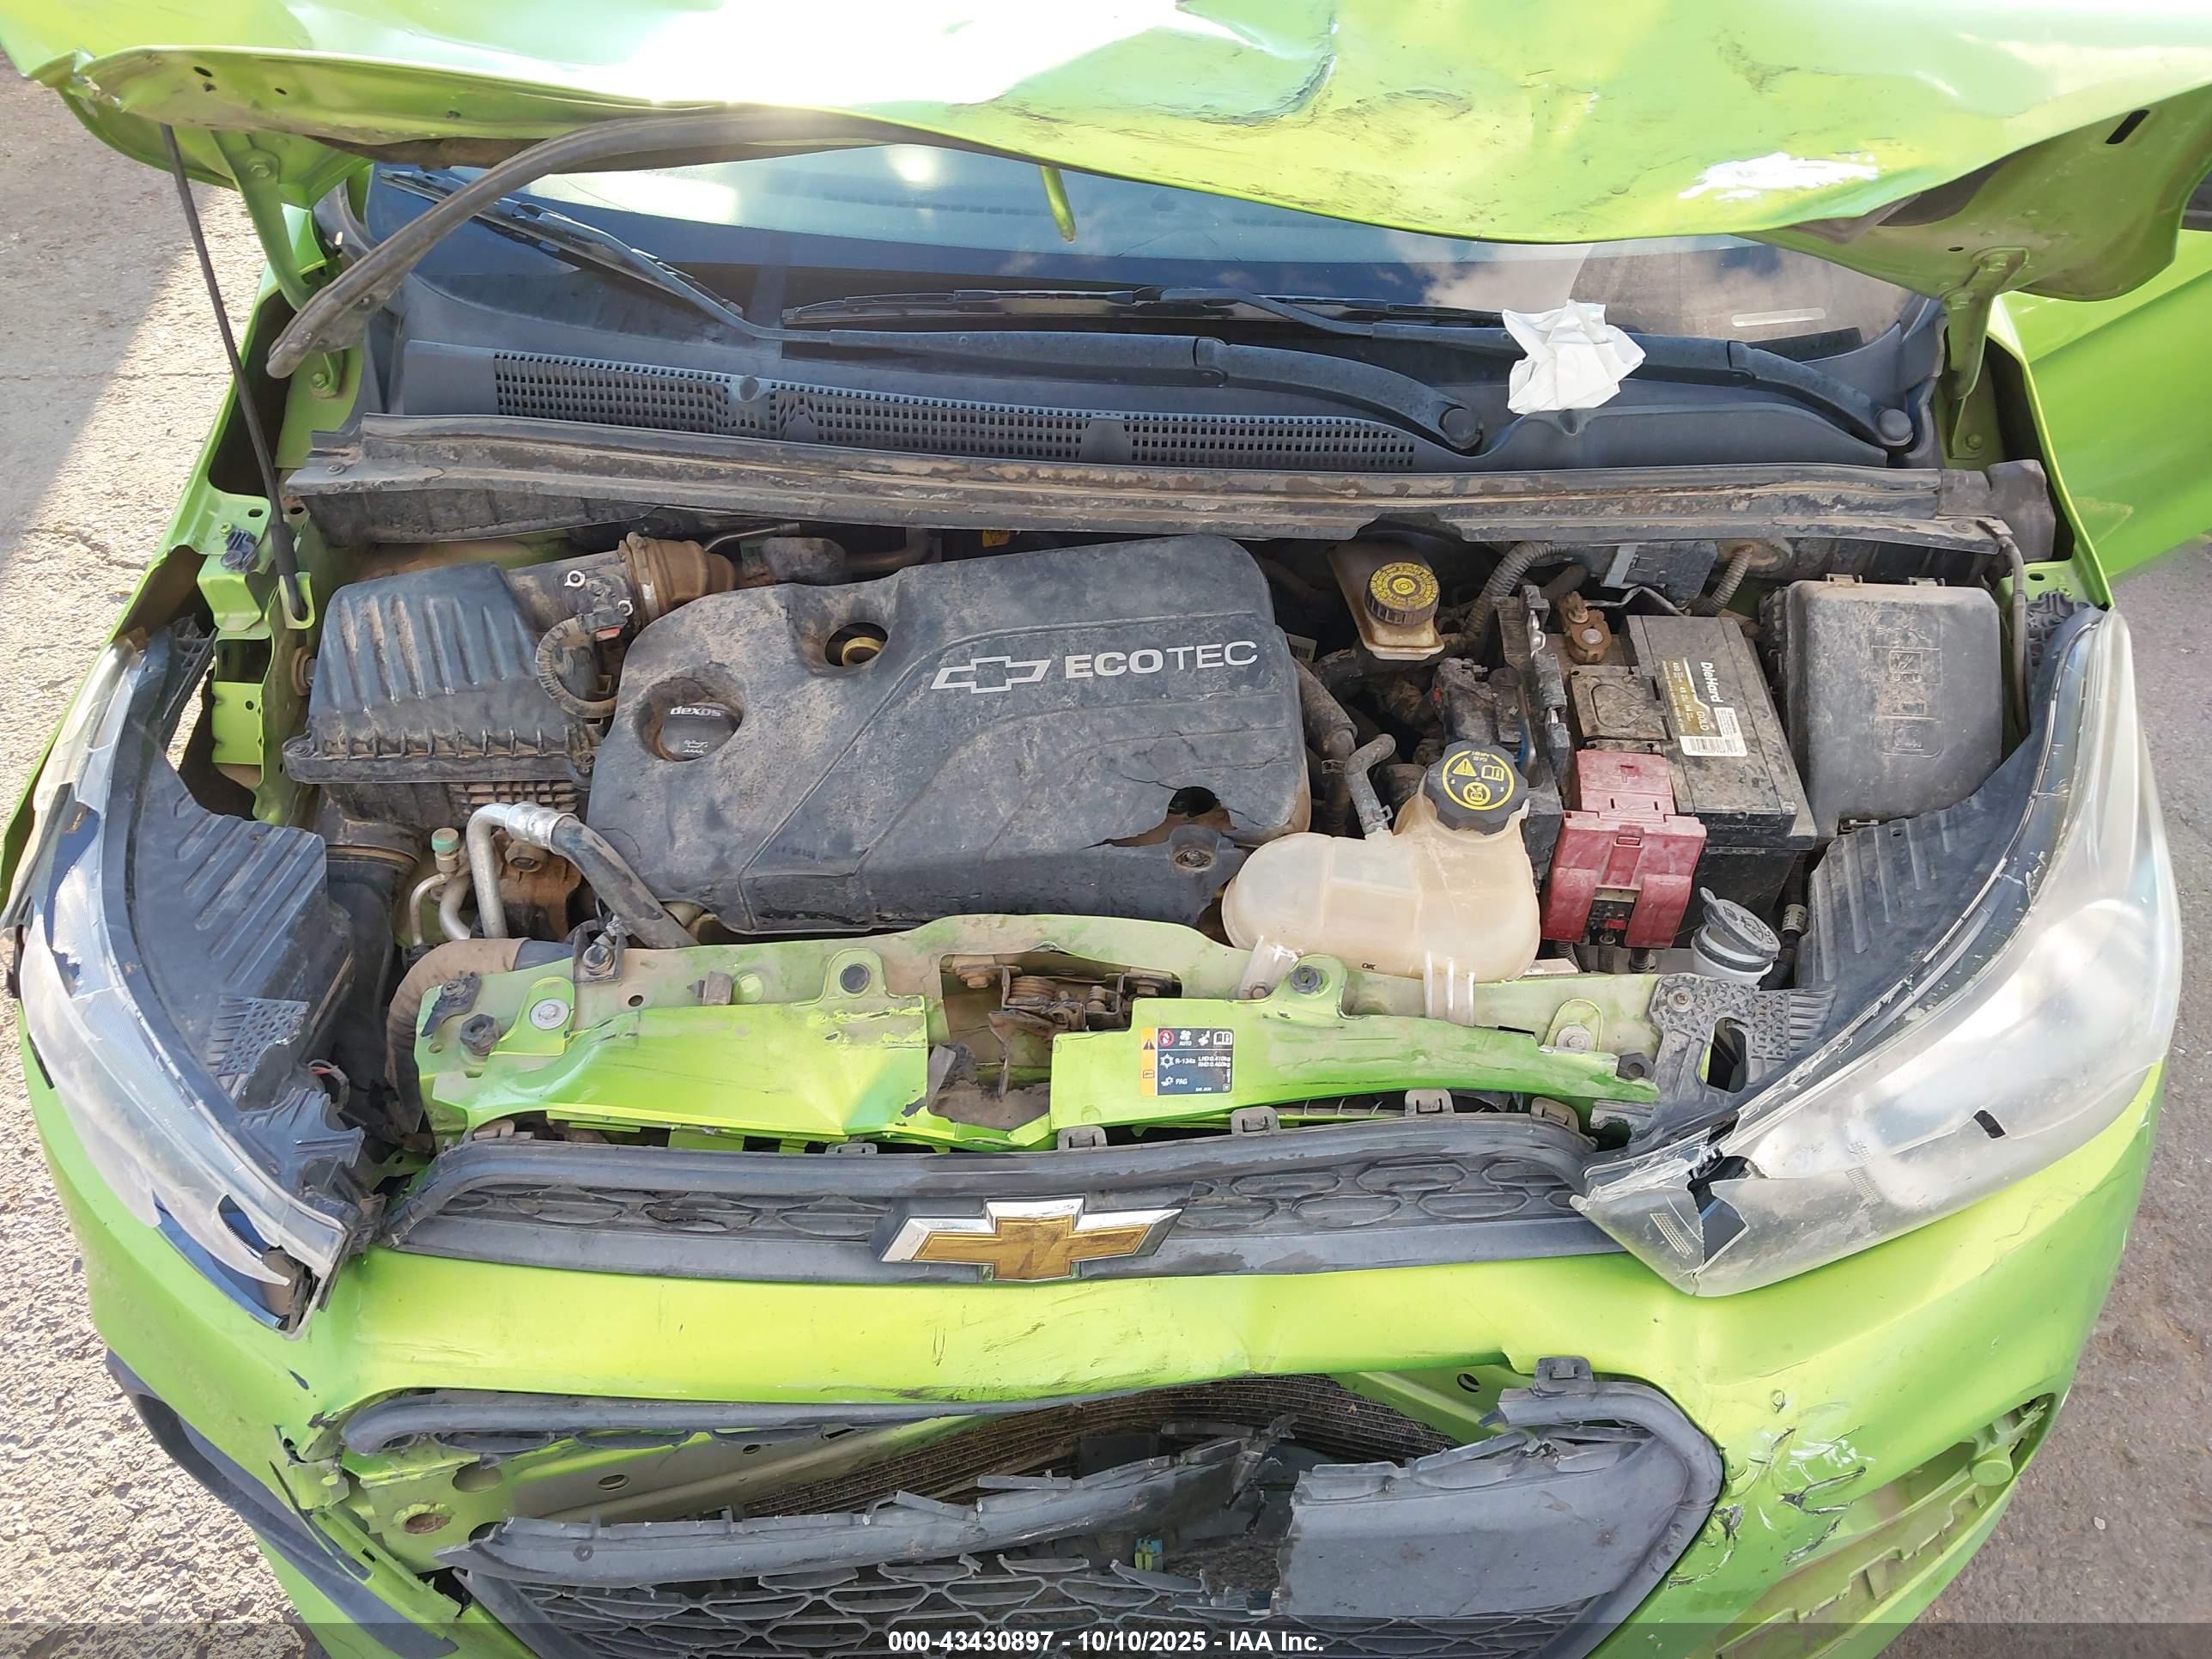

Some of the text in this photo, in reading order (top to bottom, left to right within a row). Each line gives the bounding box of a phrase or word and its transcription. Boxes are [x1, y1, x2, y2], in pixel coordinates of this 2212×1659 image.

[1065, 641, 1258, 679] ECOTEC
[1700, 662, 1724, 703] DieHard
[670, 706, 722, 717] dexos
[1697, 710, 1710, 732] GOLD
